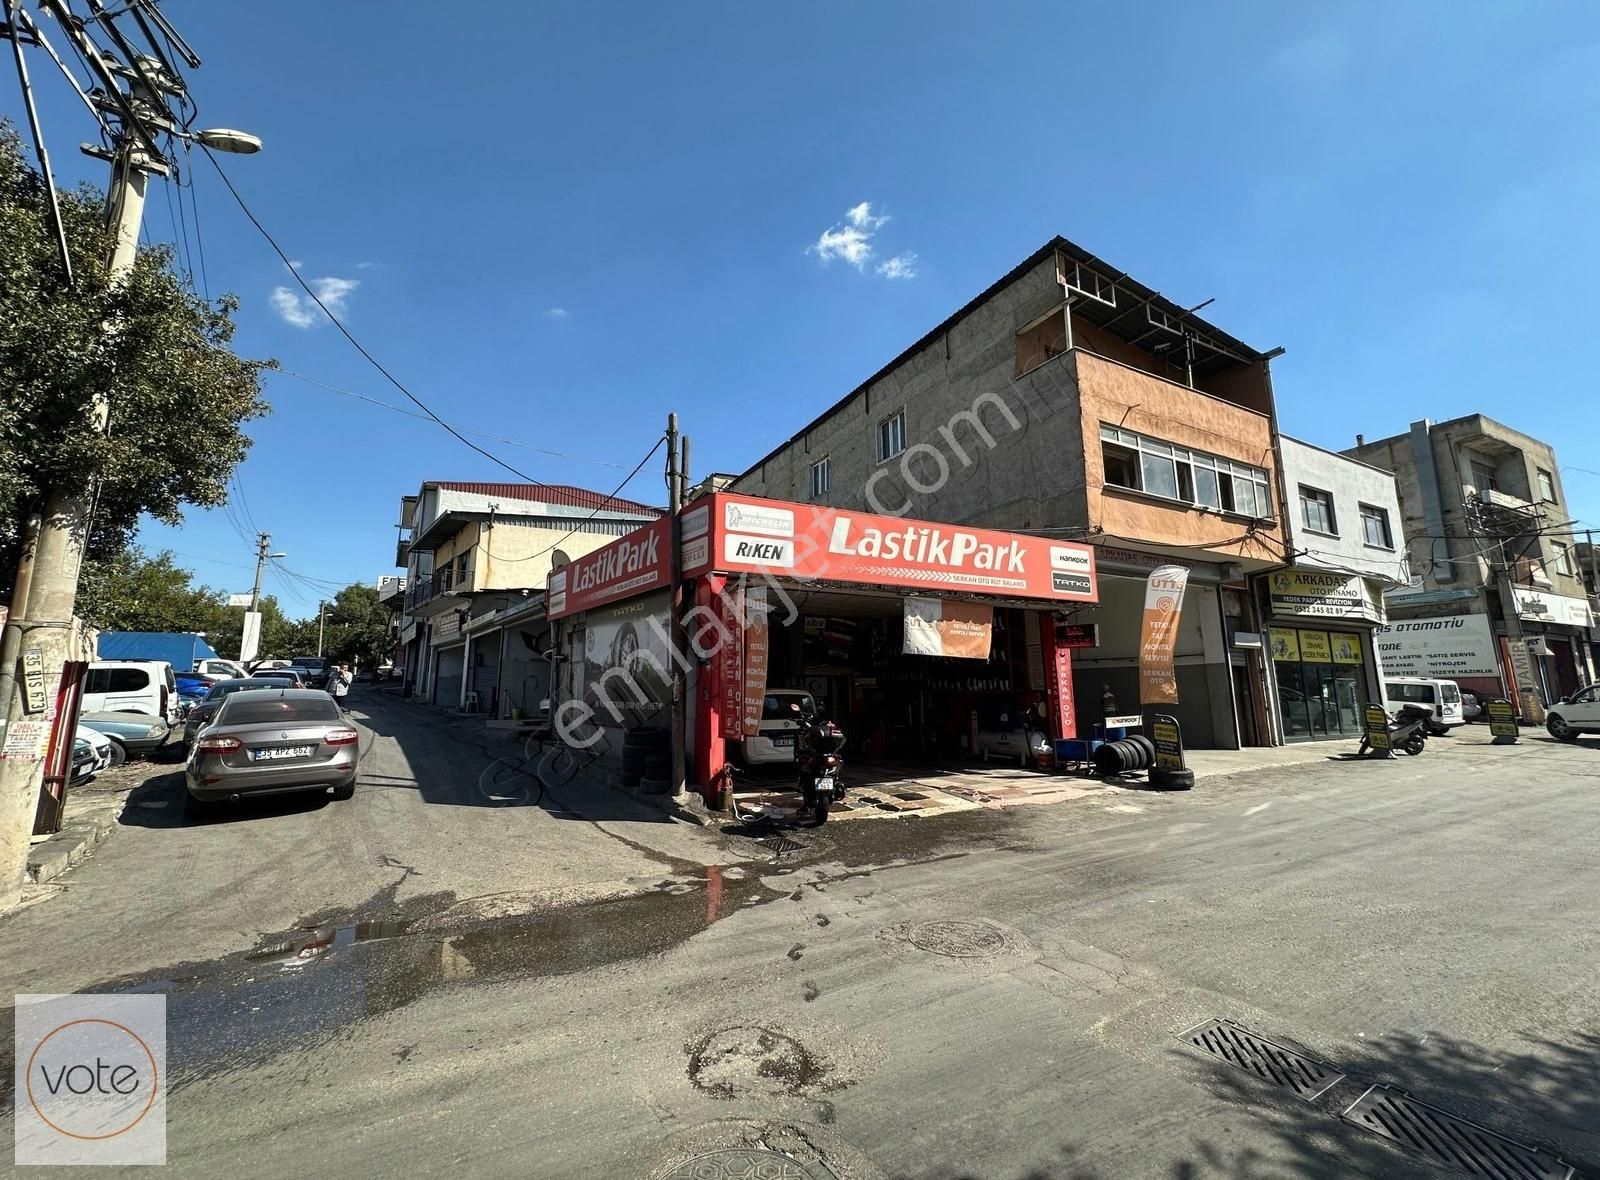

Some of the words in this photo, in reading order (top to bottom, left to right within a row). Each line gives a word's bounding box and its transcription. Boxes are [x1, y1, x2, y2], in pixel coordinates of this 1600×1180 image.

[683, 551, 705, 565] RELLI
[953, 574, 977, 584] SERKAN
[1003, 579, 1025, 588] BALANS
[1054, 577, 1090, 588] TATKO
[1294, 574, 1348, 590] ARKADAŞ
[1310, 587, 1326, 595] OTO
[612, 603, 645, 617] TATKO
[26, 655, 41, 666] 35
[30, 691, 46, 710] 673
